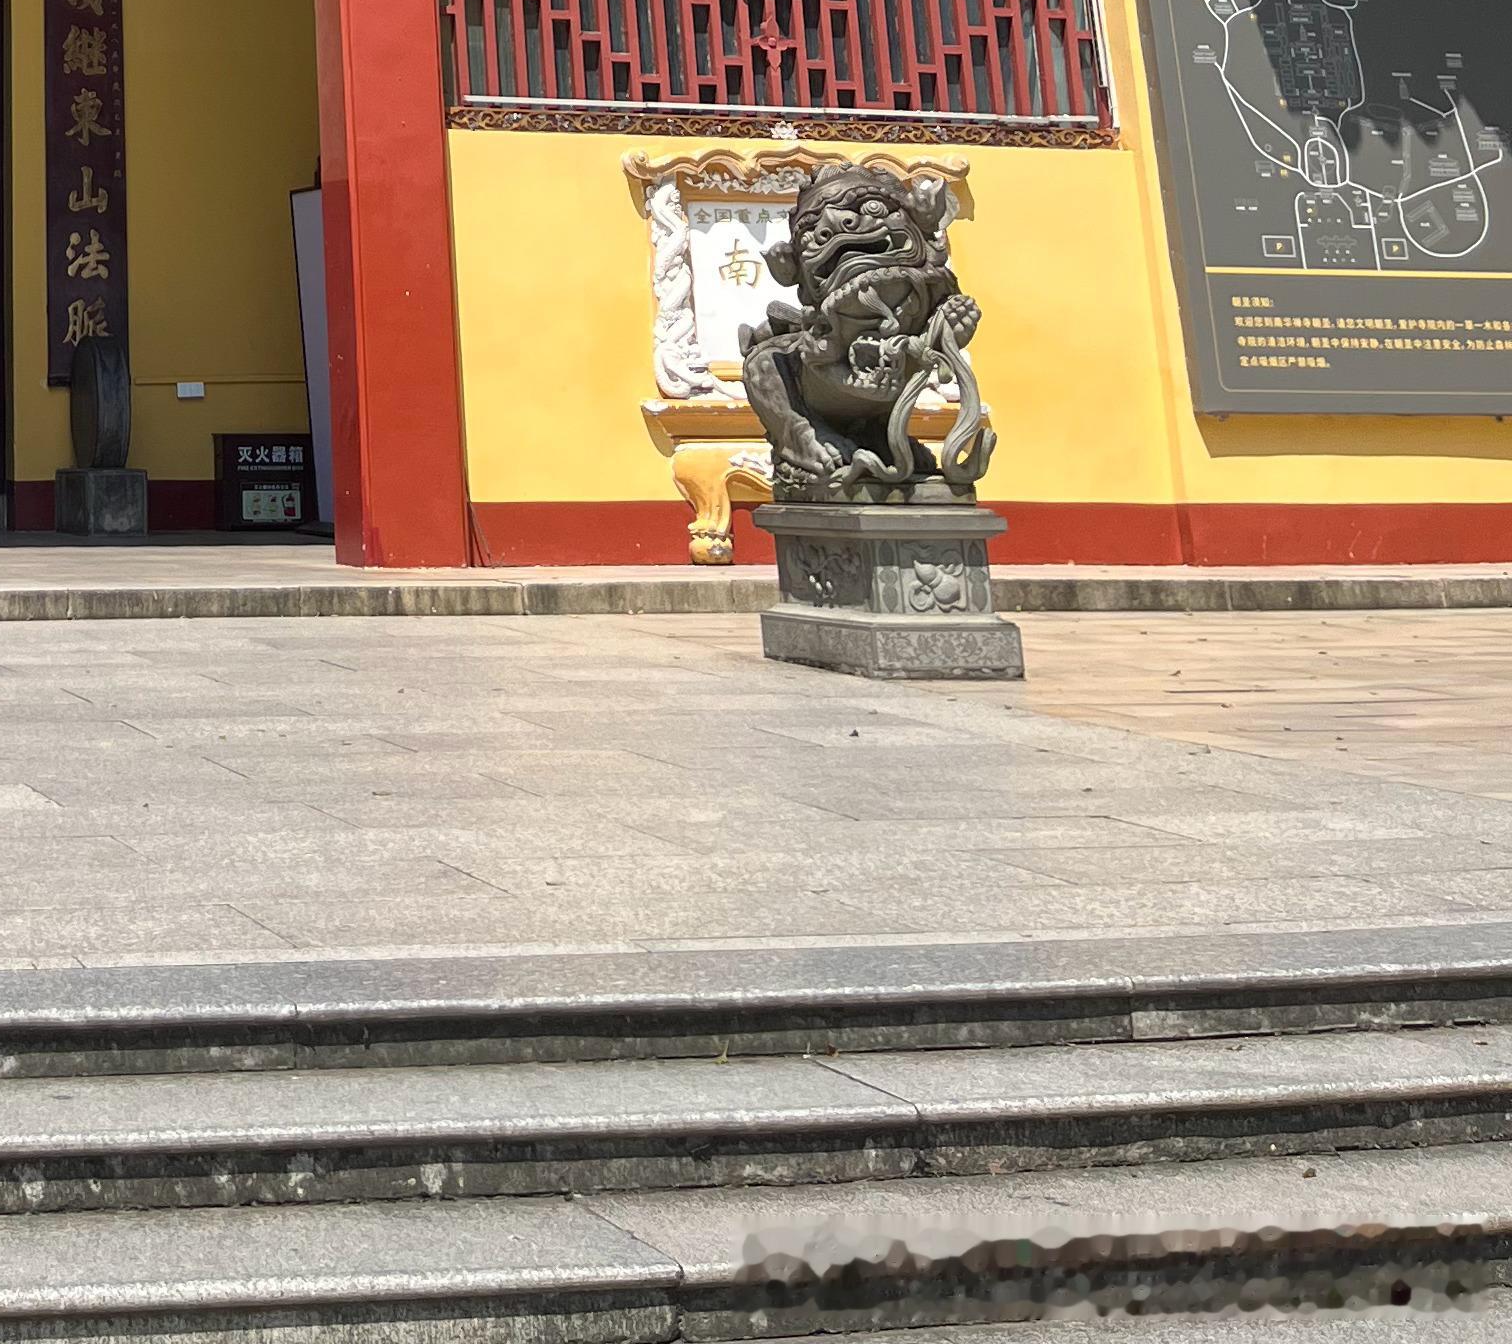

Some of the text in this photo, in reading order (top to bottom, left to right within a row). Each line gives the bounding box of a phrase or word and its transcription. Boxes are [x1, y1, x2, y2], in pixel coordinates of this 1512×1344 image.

[718, 238, 762, 288] 南
[237, 445, 304, 463] 灭火器箱
